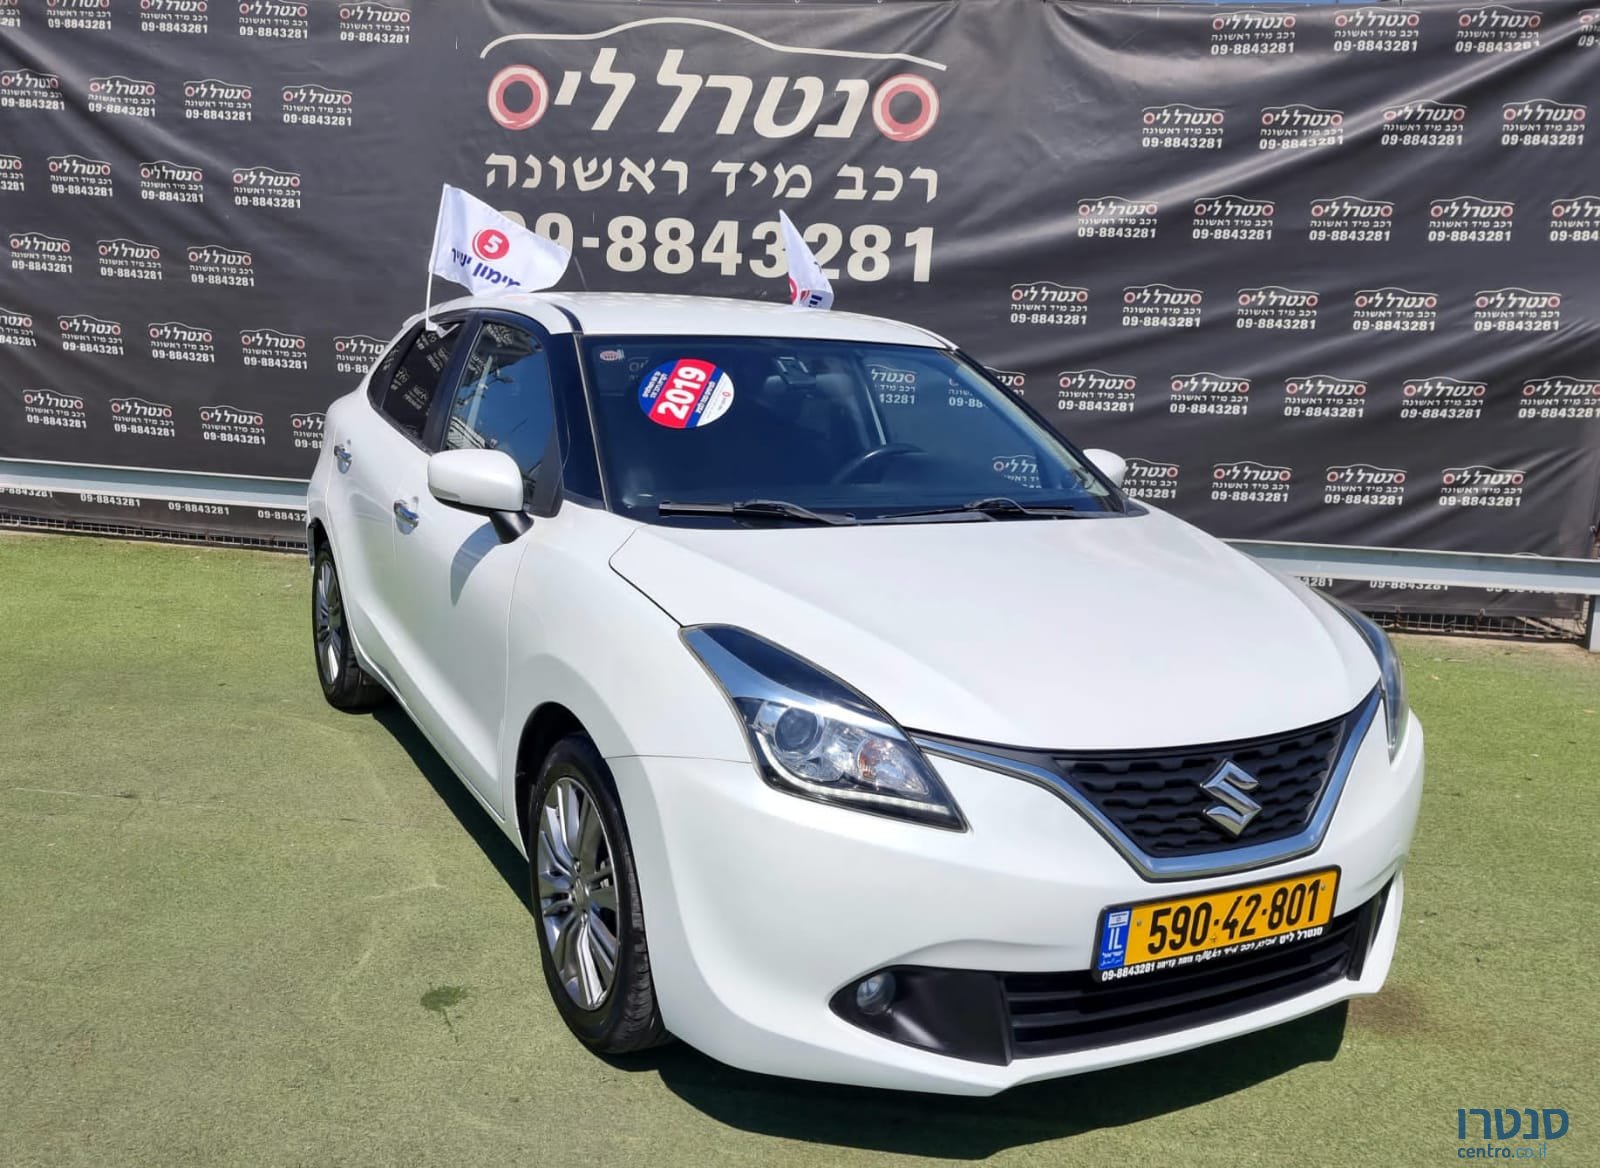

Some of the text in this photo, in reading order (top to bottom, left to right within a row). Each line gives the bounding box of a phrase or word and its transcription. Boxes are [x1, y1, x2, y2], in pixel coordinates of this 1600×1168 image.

[141, 22, 207, 34] 09-8843281
[340, 22, 373, 30] ראשונה
[240, 26, 307, 39] 09-8843281
[340, 31, 409, 44] 09-8843281
[1211, 33, 1251, 41] ראשונה
[1334, 30, 1374, 38] ראשונה
[1211, 42, 1294, 55] 09-8843281
[1335, 40, 1418, 52] 09-8843281
[90, 104, 155, 116] 09-8843281
[186, 109, 251, 121] 09-8843281
[283, 114, 351, 126] 09-8843281
[1142, 137, 1222, 148] 09-8843281
[1382, 135, 1462, 146] 09-8843281
[1502, 135, 1583, 146] 09-8843281
[485, 153, 938, 203] רכב מיד ראשונה
[52, 184, 112, 197] 09-8843281
[143, 190, 203, 203] 09-8843281
[235, 196, 300, 208] 09-8843281
[1078, 228, 1156, 237] 09-8843281
[1193, 229, 1272, 240] 09-8843281
[1310, 230, 1390, 241] 09-8843281
[1429, 231, 1511, 242] 09-8843281
[483, 234, 503, 254] 5
[500, 210, 934, 282] 9-8843281
[12, 260, 72, 273] 09-8843281
[101, 267, 162, 280] 09-8843281
[191, 274, 254, 286] 09-8843281
[1011, 313, 1086, 325] 09-8843281
[1123, 316, 1200, 327] 09-8843281
[1237, 318, 1316, 329] 09-8843281
[1353, 320, 1435, 331] 09-8843281
[1475, 321, 1559, 331] 09-8843281
[63, 342, 123, 355] 09-8843281
[152, 349, 214, 362] 09-8843281
[244, 356, 307, 369] 09-8843281
[657, 366, 706, 420] 2019
[1058, 400, 1134, 412] 09-8843281
[1170, 403, 1247, 415] 09-8843281
[1284, 406, 1363, 418] 09-8843281
[1401, 409, 1481, 418] 09-8843281
[27, 414, 86, 428] 09-8843281
[115, 423, 175, 437] 09-8843281
[204, 432, 265, 444] 09-8843281
[1212, 491, 1288, 502] 09-8843281
[1325, 494, 1403, 505] 09-8843281
[1108, 928, 1122, 951] IL
[1102, 962, 1155, 982] 09-8843281
